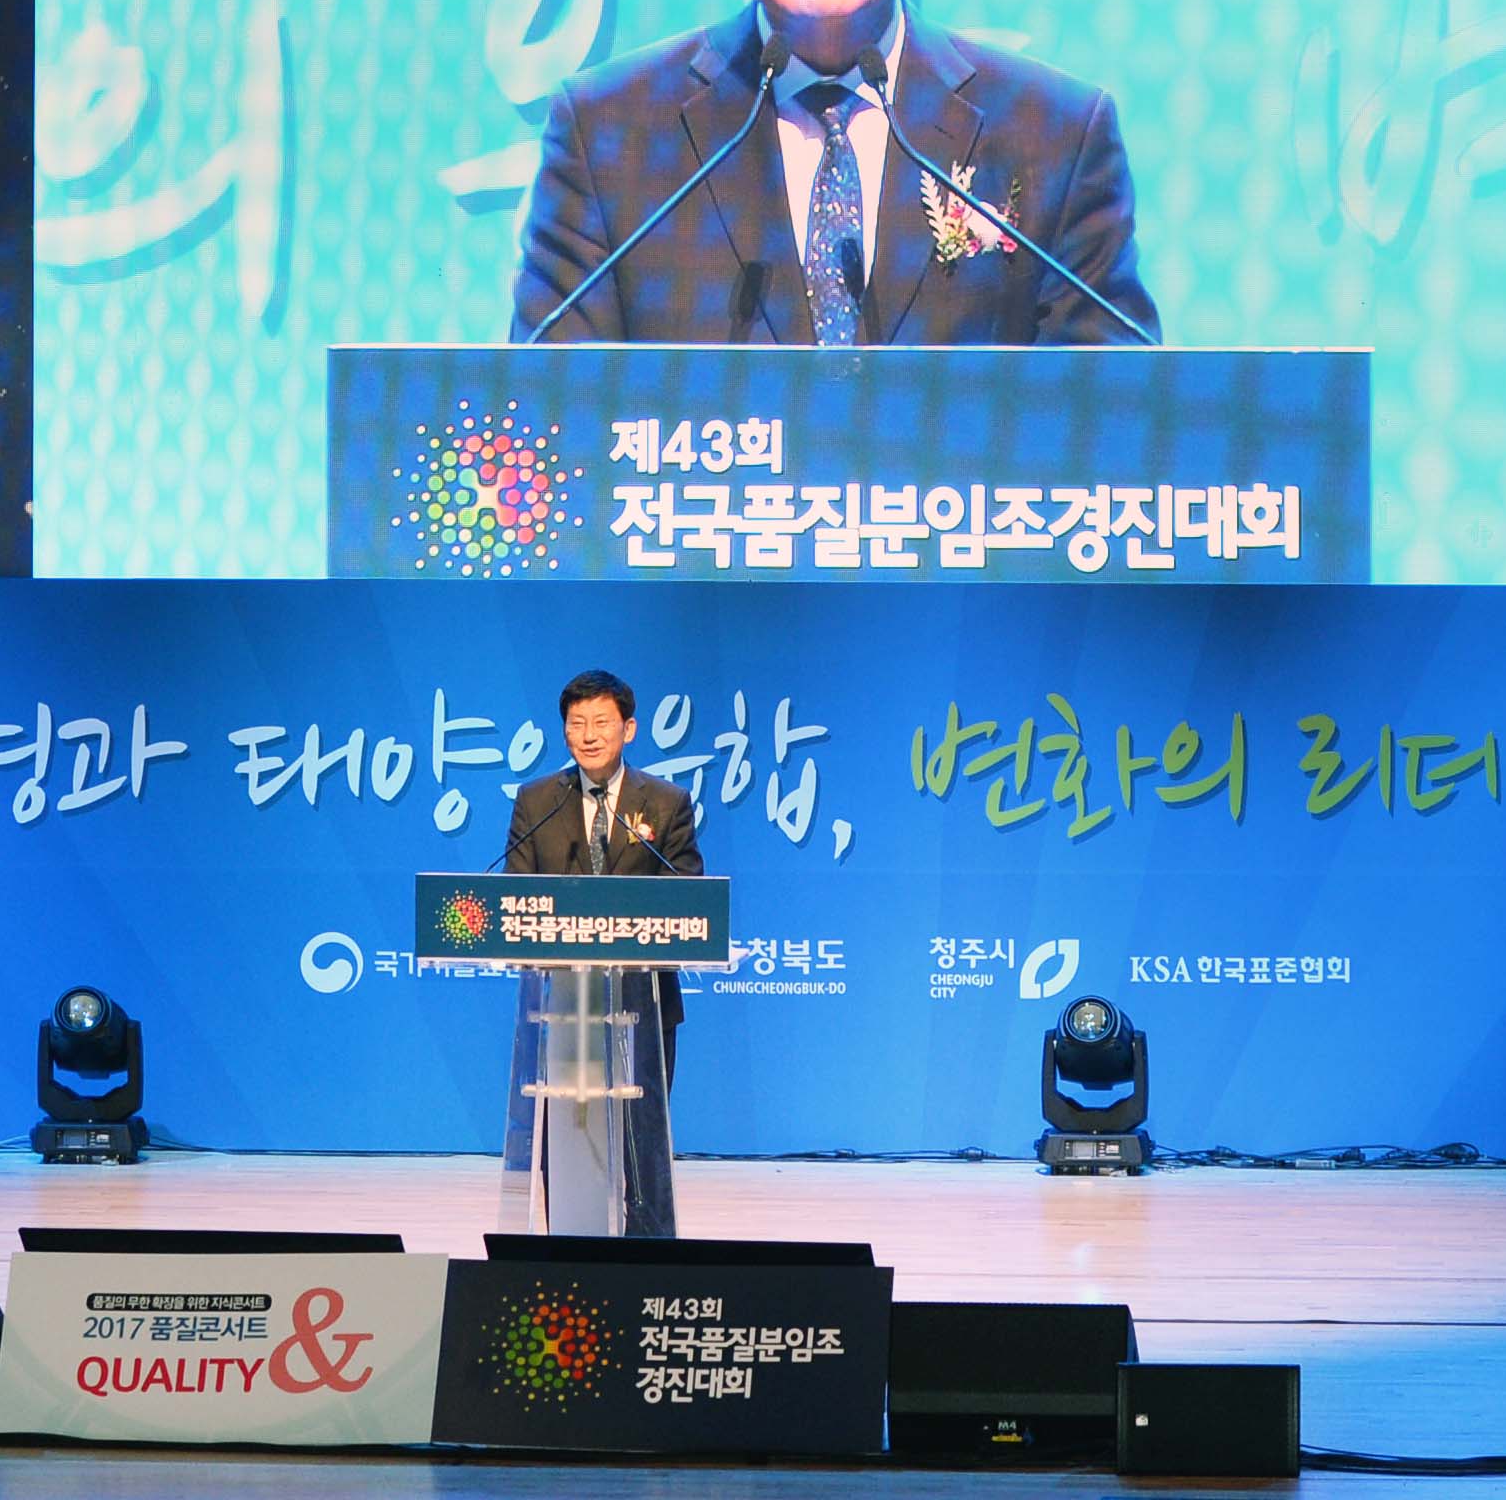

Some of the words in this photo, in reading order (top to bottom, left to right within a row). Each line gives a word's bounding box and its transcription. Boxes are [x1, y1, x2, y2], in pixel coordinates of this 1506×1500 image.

[609, 417, 784, 475] 제43회
[609, 481, 1301, 572] 전국품질분임조경진대회
[911, 693, 1247, 837] 변화의
[1297, 713, 1499, 815] 리더
[500, 895, 554, 914] 제43회
[500, 915, 709, 945] 전국품질분임조경진대회
[929, 936, 1015, 969] 청주시
[930, 973, 994, 989] CHEONGJU
[1129, 955, 1193, 984] KSA
[1197, 955, 1352, 985] 한국표준협회
[713, 980, 847, 995] CHUNGCHEONGBUK-DO
[930, 986, 957, 999] CITY
[641, 1297, 723, 1321] 제43회
[82, 1316, 145, 1340] 2017
[149, 1315, 268, 1342] 품질콘서트
[638, 1326, 845, 1363] 전국품질분임조
[76, 1355, 265, 1397] QUALITY
[635, 1366, 753, 1404] 경진대회
